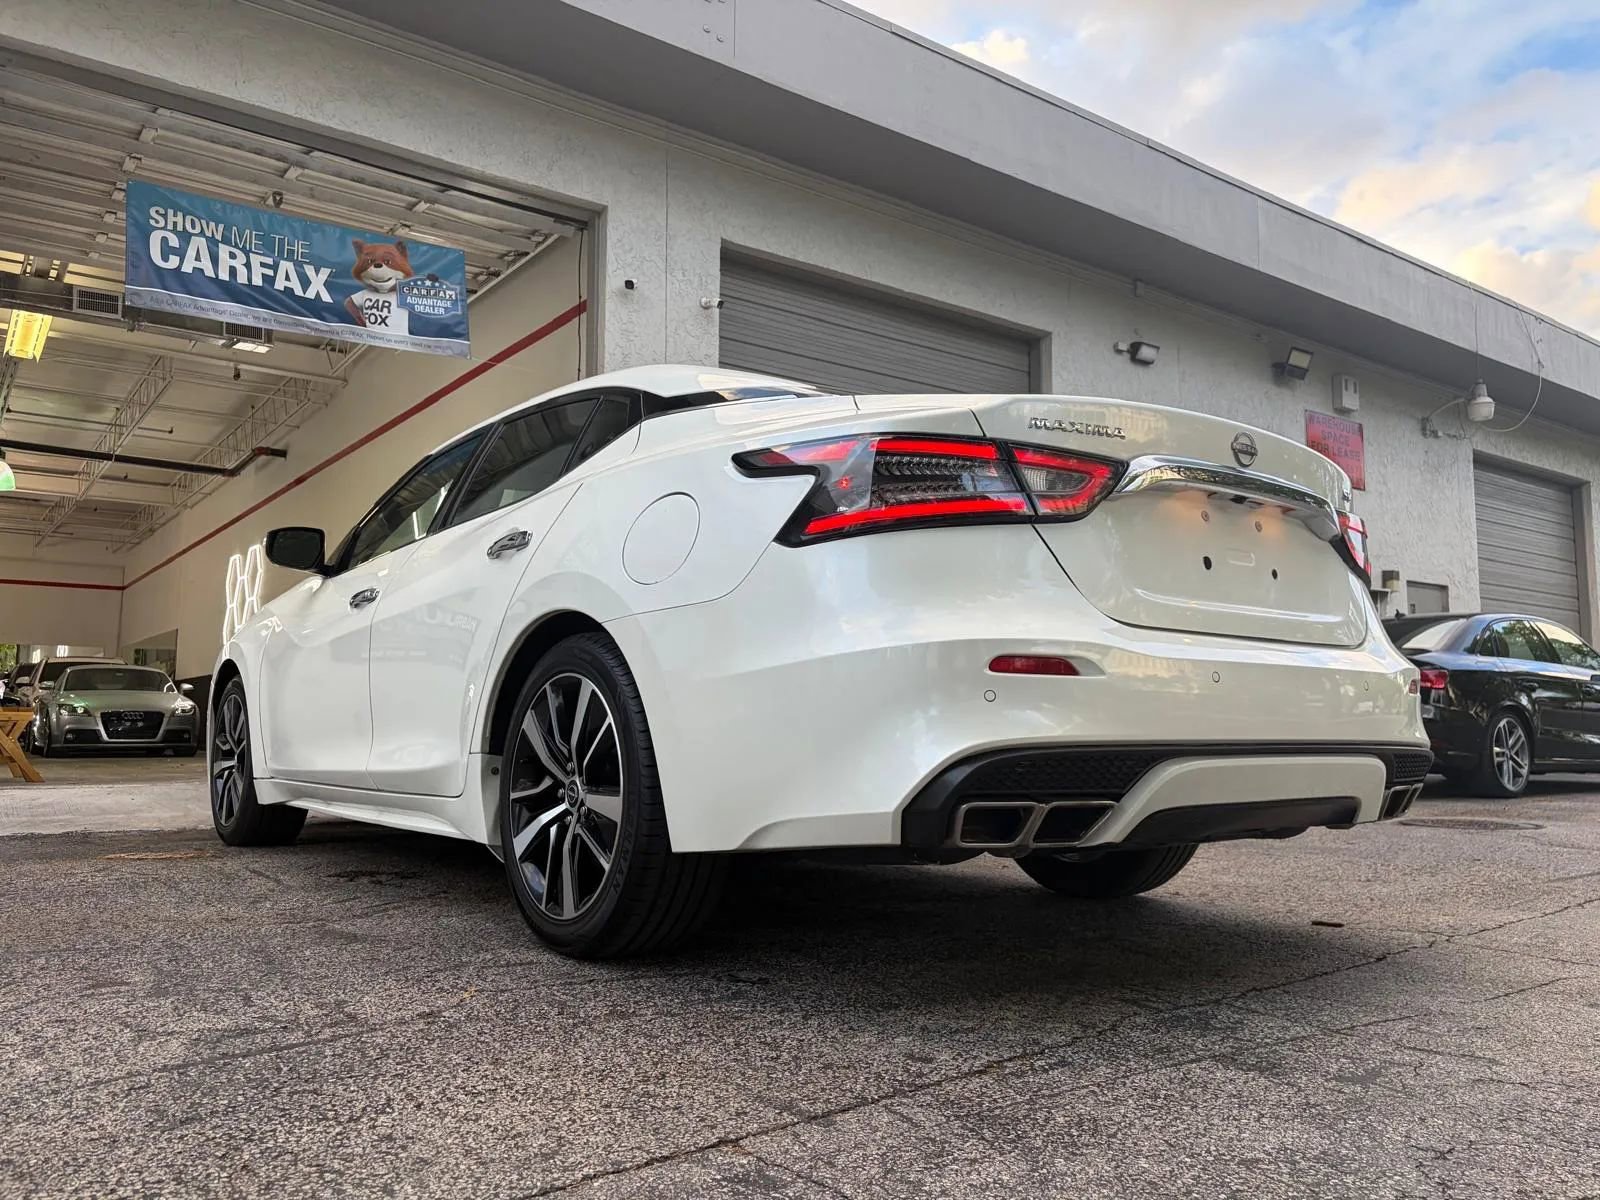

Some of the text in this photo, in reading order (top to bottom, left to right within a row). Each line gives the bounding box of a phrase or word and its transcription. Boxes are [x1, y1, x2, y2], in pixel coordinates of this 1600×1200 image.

[149, 206, 311, 262] SHOW ME THE
[149, 229, 335, 304] CARFAX
[402, 286, 456, 300] CARFAX
[363, 297, 392, 315] CAR
[406, 296, 453, 308] ADVANTAGE
[414, 304, 446, 315] DEALER
[1028, 417, 1126, 439] MAXIMA
[1321, 430, 1351, 447] SPACE
